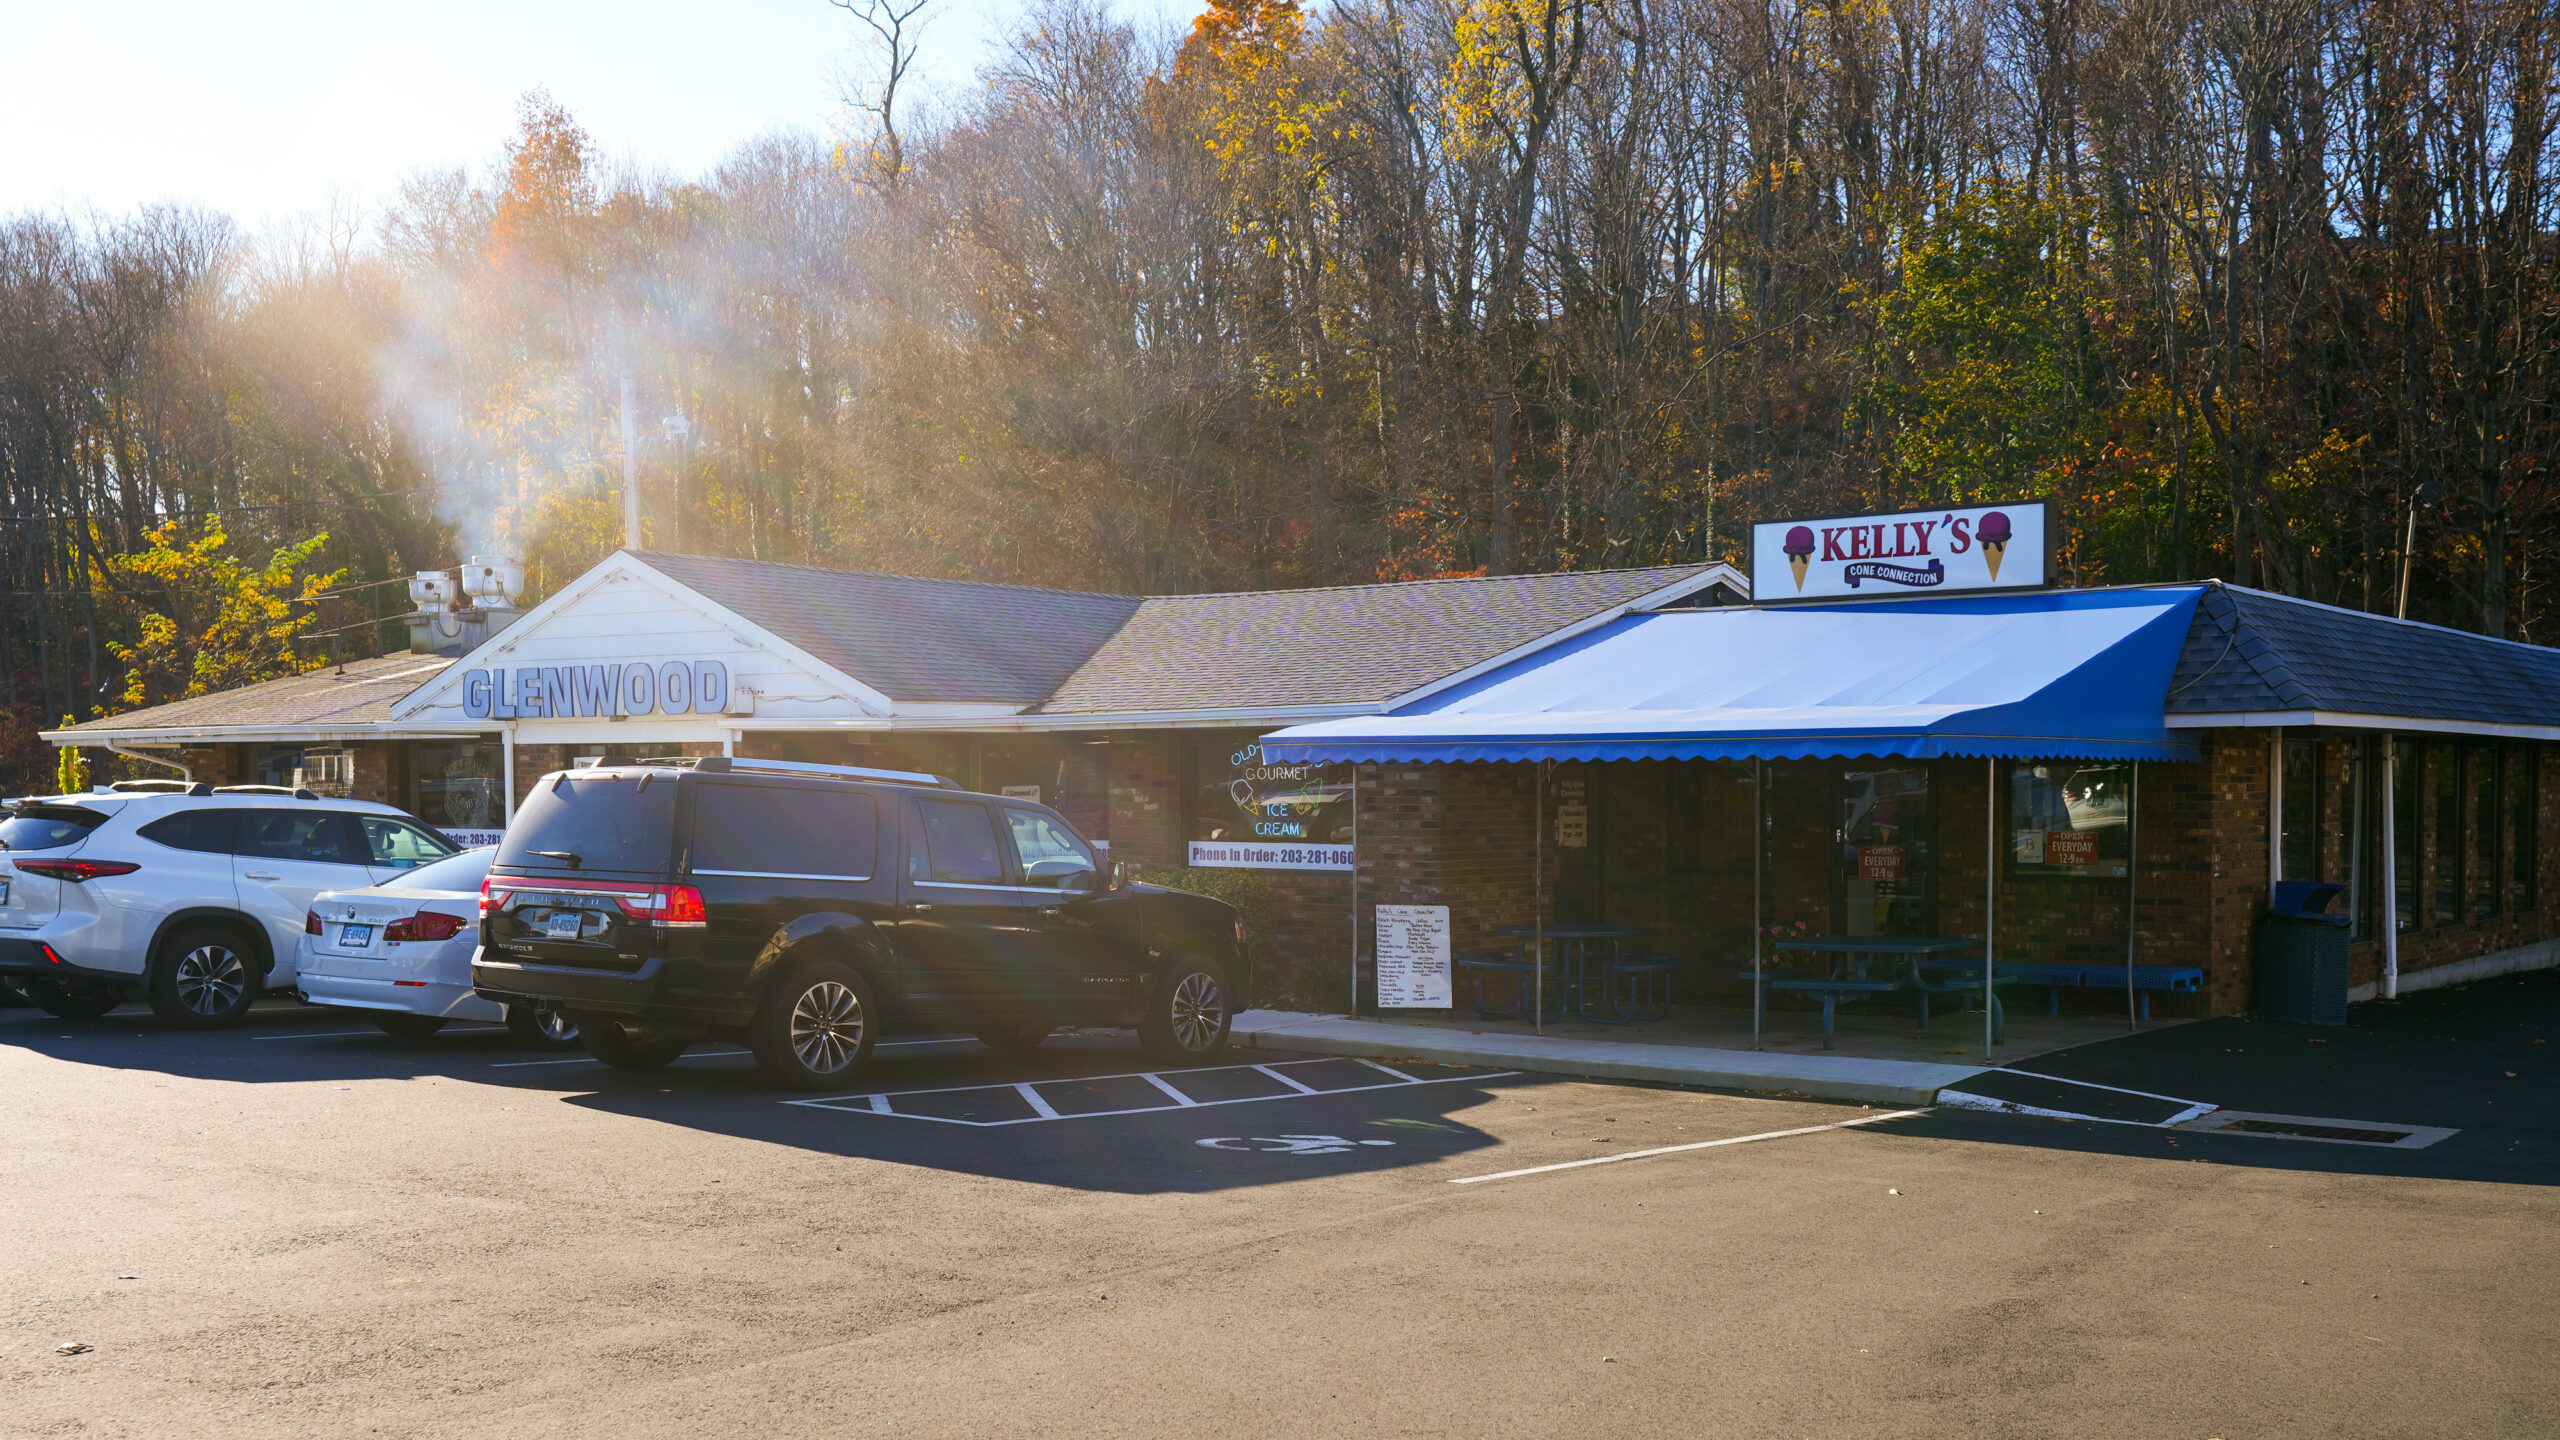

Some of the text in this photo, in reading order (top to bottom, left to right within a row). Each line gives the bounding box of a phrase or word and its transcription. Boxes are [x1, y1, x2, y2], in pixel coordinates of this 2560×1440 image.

[1821, 513, 1971, 562] KELLY'S
[1850, 564, 1938, 584] CONE CONNECTION
[462, 660, 728, 719] GLENWOOD
[1245, 767, 1308, 780] GOURMET
[1267, 803, 1289, 817] ICE
[1255, 822, 1300, 836] CREAM
[2060, 832, 2084, 840] OPEN
[1872, 847, 1894, 855] OPEN
[2052, 841, 2093, 853] EVERYDAY
[1193, 847, 1226, 861] Phone
[1230, 848, 1240, 861] In
[1244, 848, 1278, 863] Order:
[1864, 856, 1900, 867] EVERYDAY
[2059, 853, 2075, 864] 12-9
